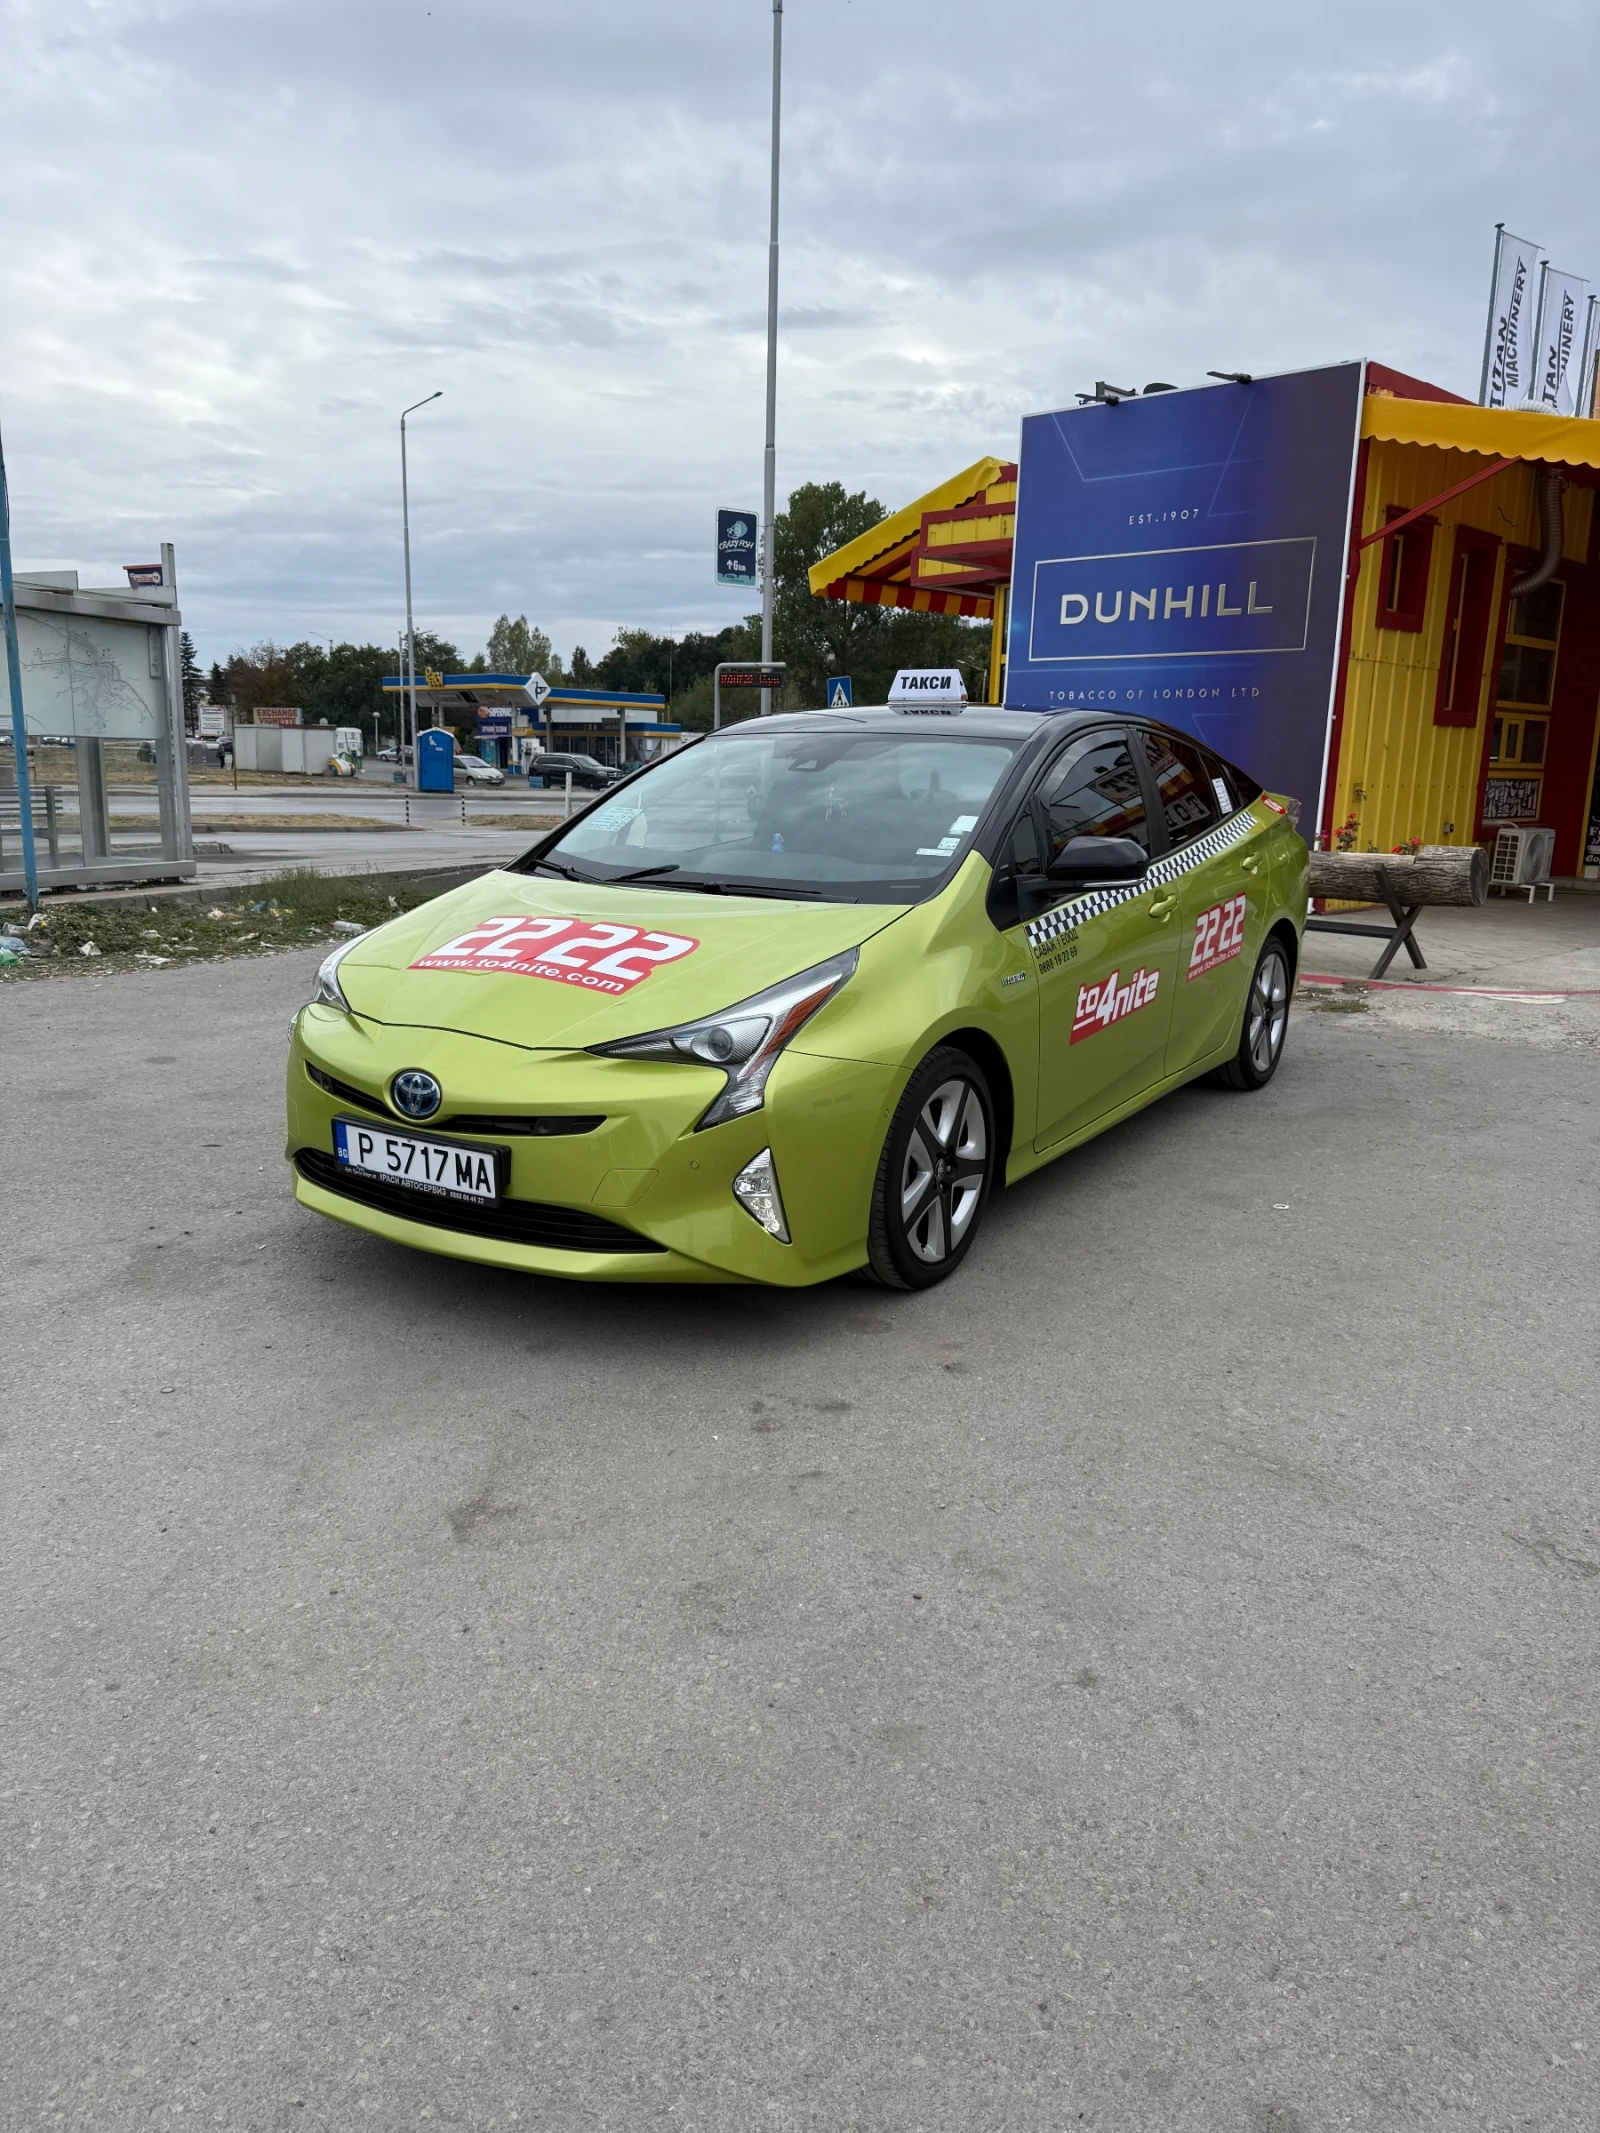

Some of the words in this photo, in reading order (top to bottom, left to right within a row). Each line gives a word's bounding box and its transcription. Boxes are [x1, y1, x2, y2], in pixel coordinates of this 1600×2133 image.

[1506, 260, 1527, 388] MACHINERY
[719, 539, 740, 550] CRAZY
[739, 539, 754, 549] FISH
[1060, 581, 1273, 625] DUNHILL
[901, 676, 952, 690] ТАКСИ
[1050, 690, 1117, 700] TOBACCO
[1127, 689, 1144, 699] OF
[1154, 688, 1220, 699] LONDON
[1232, 687, 1260, 698] LTD
[257, 708, 298, 717] EXCHANGE
[1033, 942, 1057, 959] САВАЖ
[1060, 928, 1079, 946] ЕООД
[1062, 950, 1071, 963] 22
[1188, 945, 1241, 979] www.to4nite.com
[418, 957, 625, 992] www.to4nite.com
[1075, 970, 1160, 1026] to4nite
[338, 1147, 348, 1158] BG
[386, 1139, 448, 1182] 5717
[455, 1153, 492, 1193] MA
[401, 1178, 447, 1196] АВТОСЕРВИЗ
